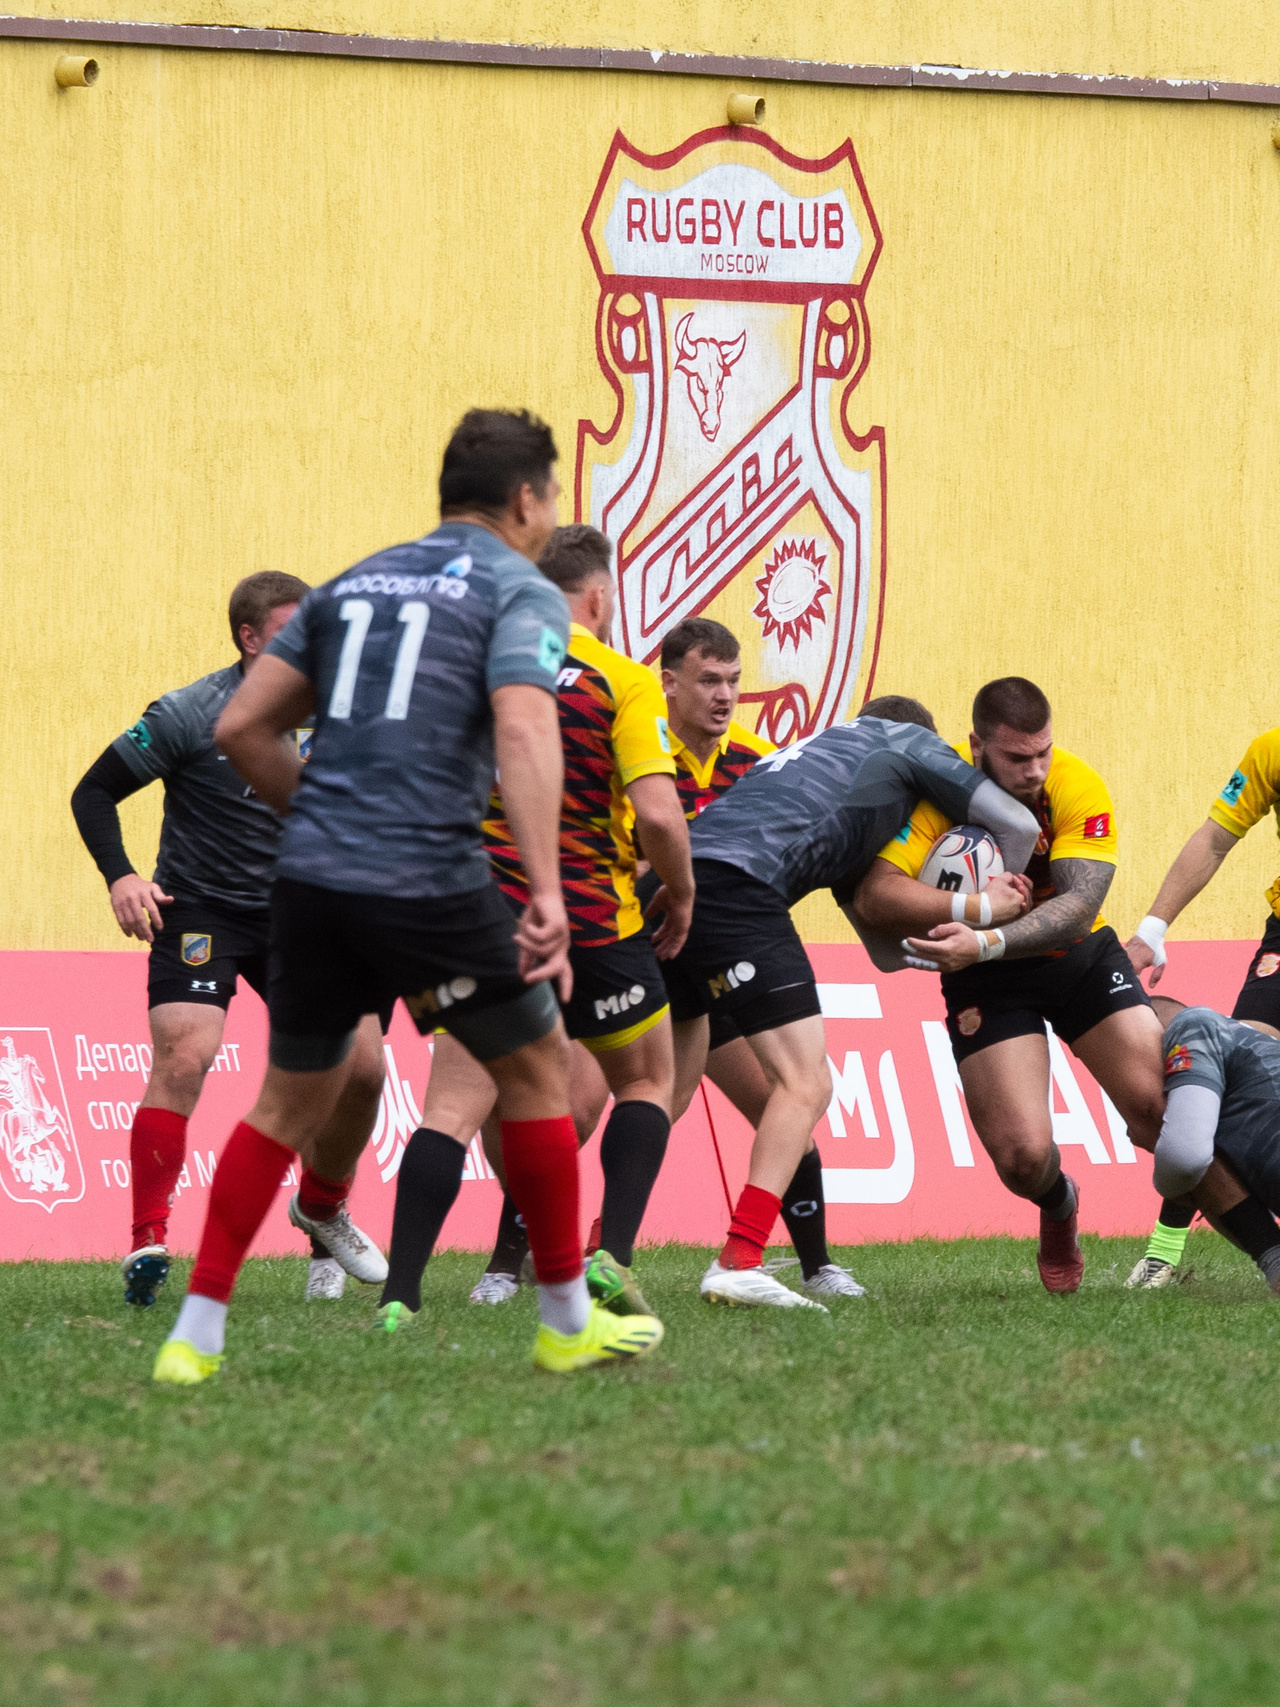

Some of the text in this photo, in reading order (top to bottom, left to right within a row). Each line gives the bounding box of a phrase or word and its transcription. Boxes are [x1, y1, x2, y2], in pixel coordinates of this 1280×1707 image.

[626, 198, 846, 249] RUGBY CLUB
[701, 253, 769, 274] MOSCOW
[329, 600, 429, 720] 11
